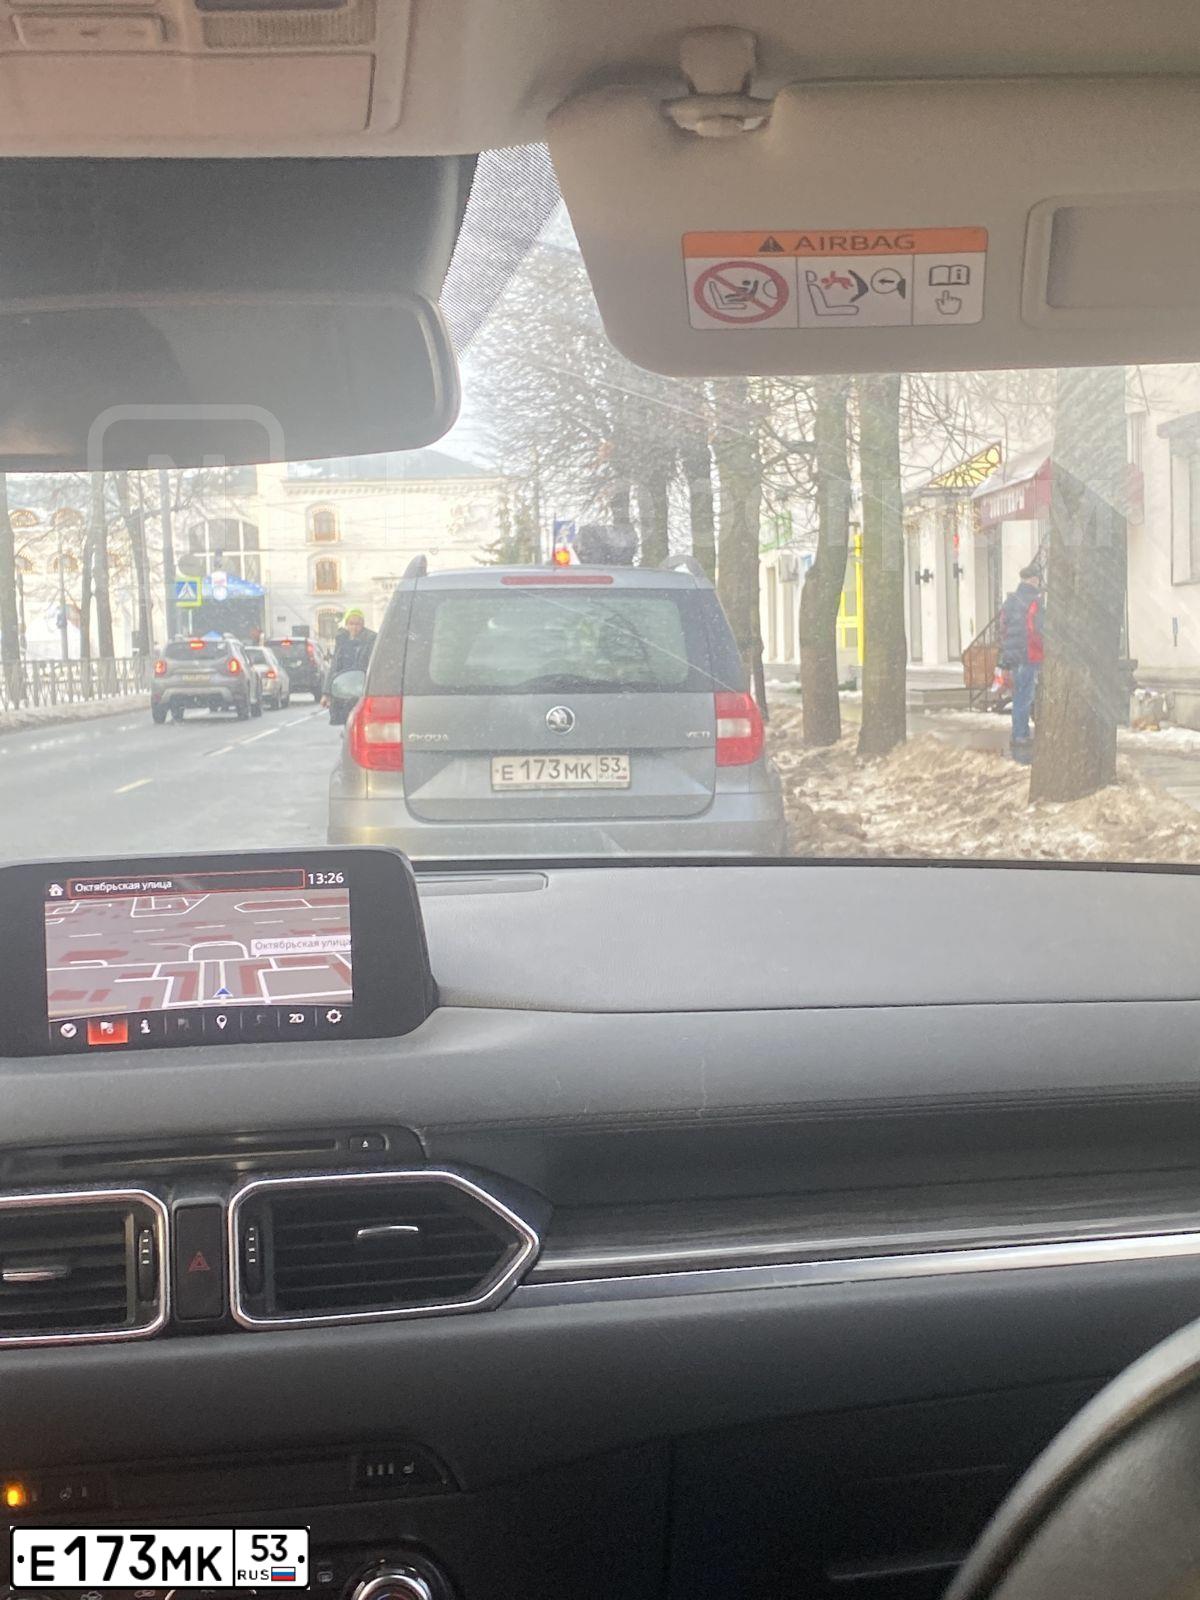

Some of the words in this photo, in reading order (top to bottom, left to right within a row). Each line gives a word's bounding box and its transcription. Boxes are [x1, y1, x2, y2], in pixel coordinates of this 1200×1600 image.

[794, 233, 916, 251] AIRBAG
[599, 757, 622, 773] 53
[307, 871, 345, 885] 13:26
[74, 879, 141, 893] Октябрьская
[141, 879, 172, 891] улица
[255, 939, 319, 951] Октябрьская
[289, 1012, 305, 1023] 2D
